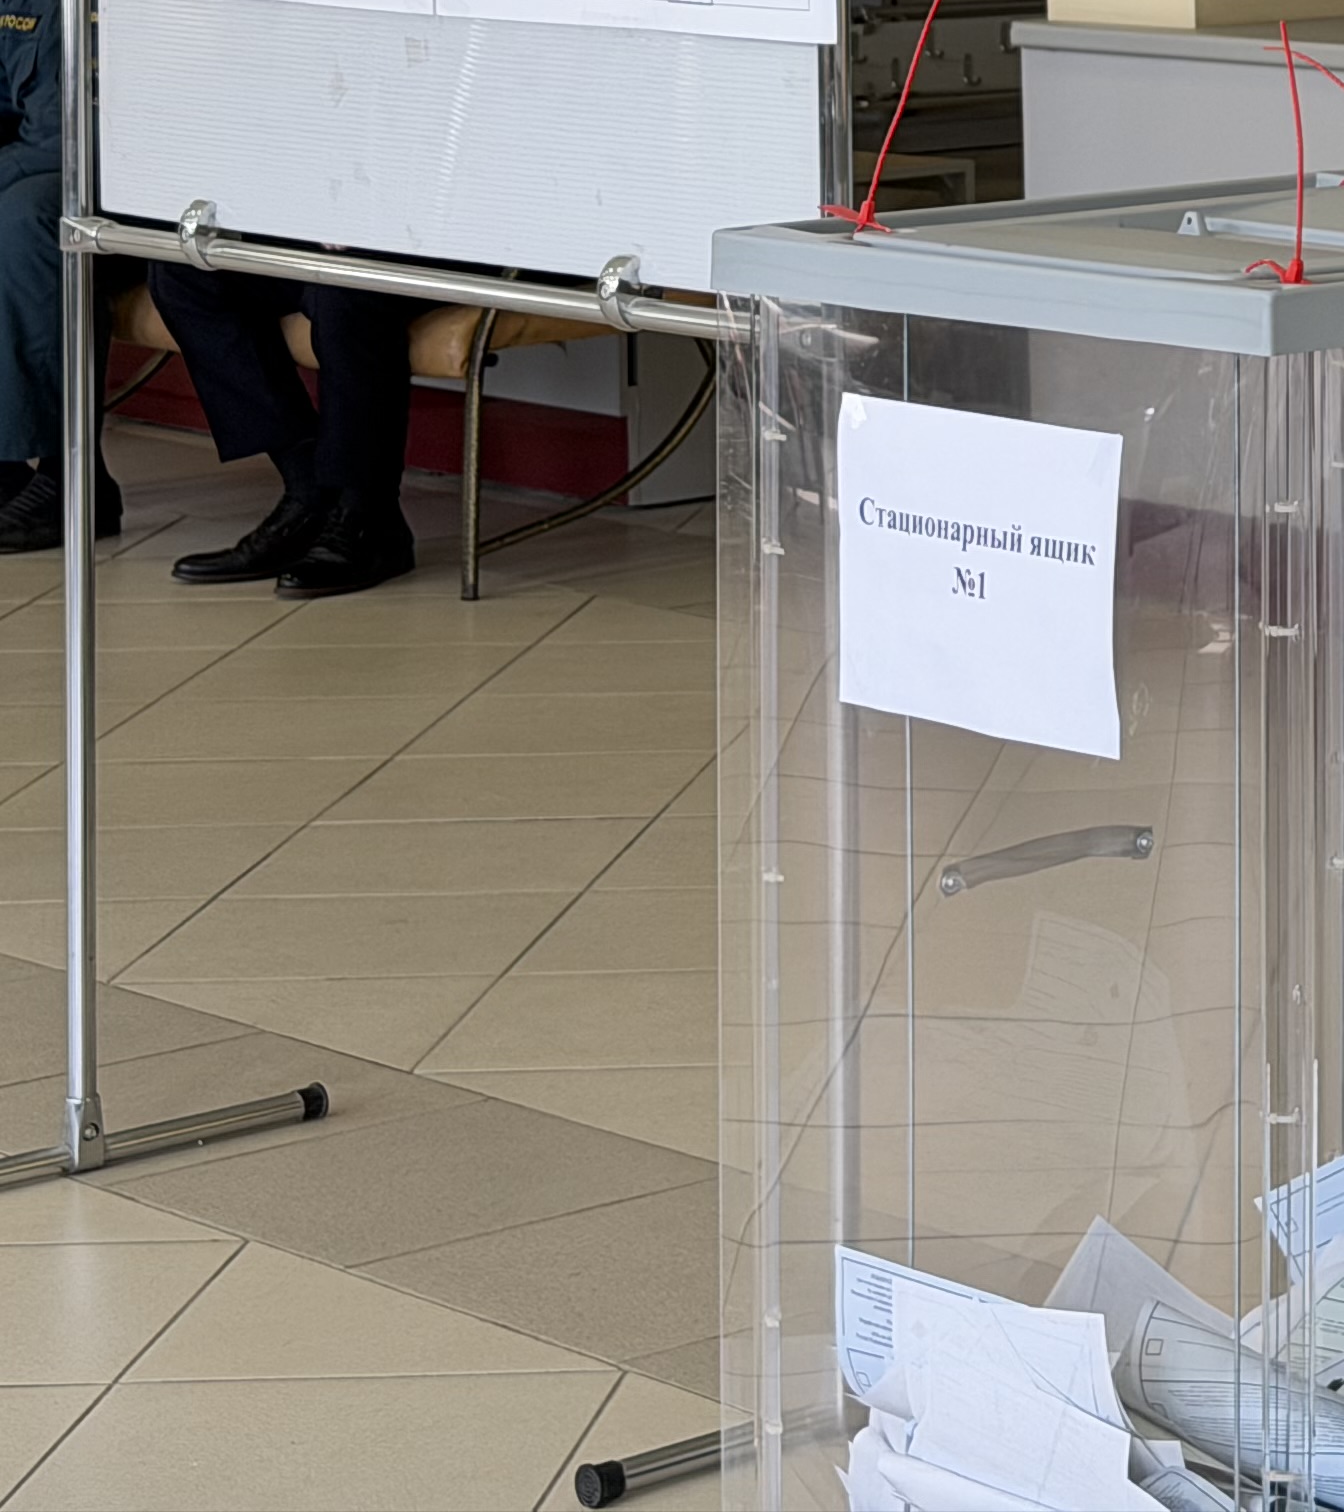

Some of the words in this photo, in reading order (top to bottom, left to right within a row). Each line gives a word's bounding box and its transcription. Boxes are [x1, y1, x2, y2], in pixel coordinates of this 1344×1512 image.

[859, 496, 1022, 554] Стационарный
[1030, 533, 1096, 566] ящик
[952, 566, 987, 600] №1
